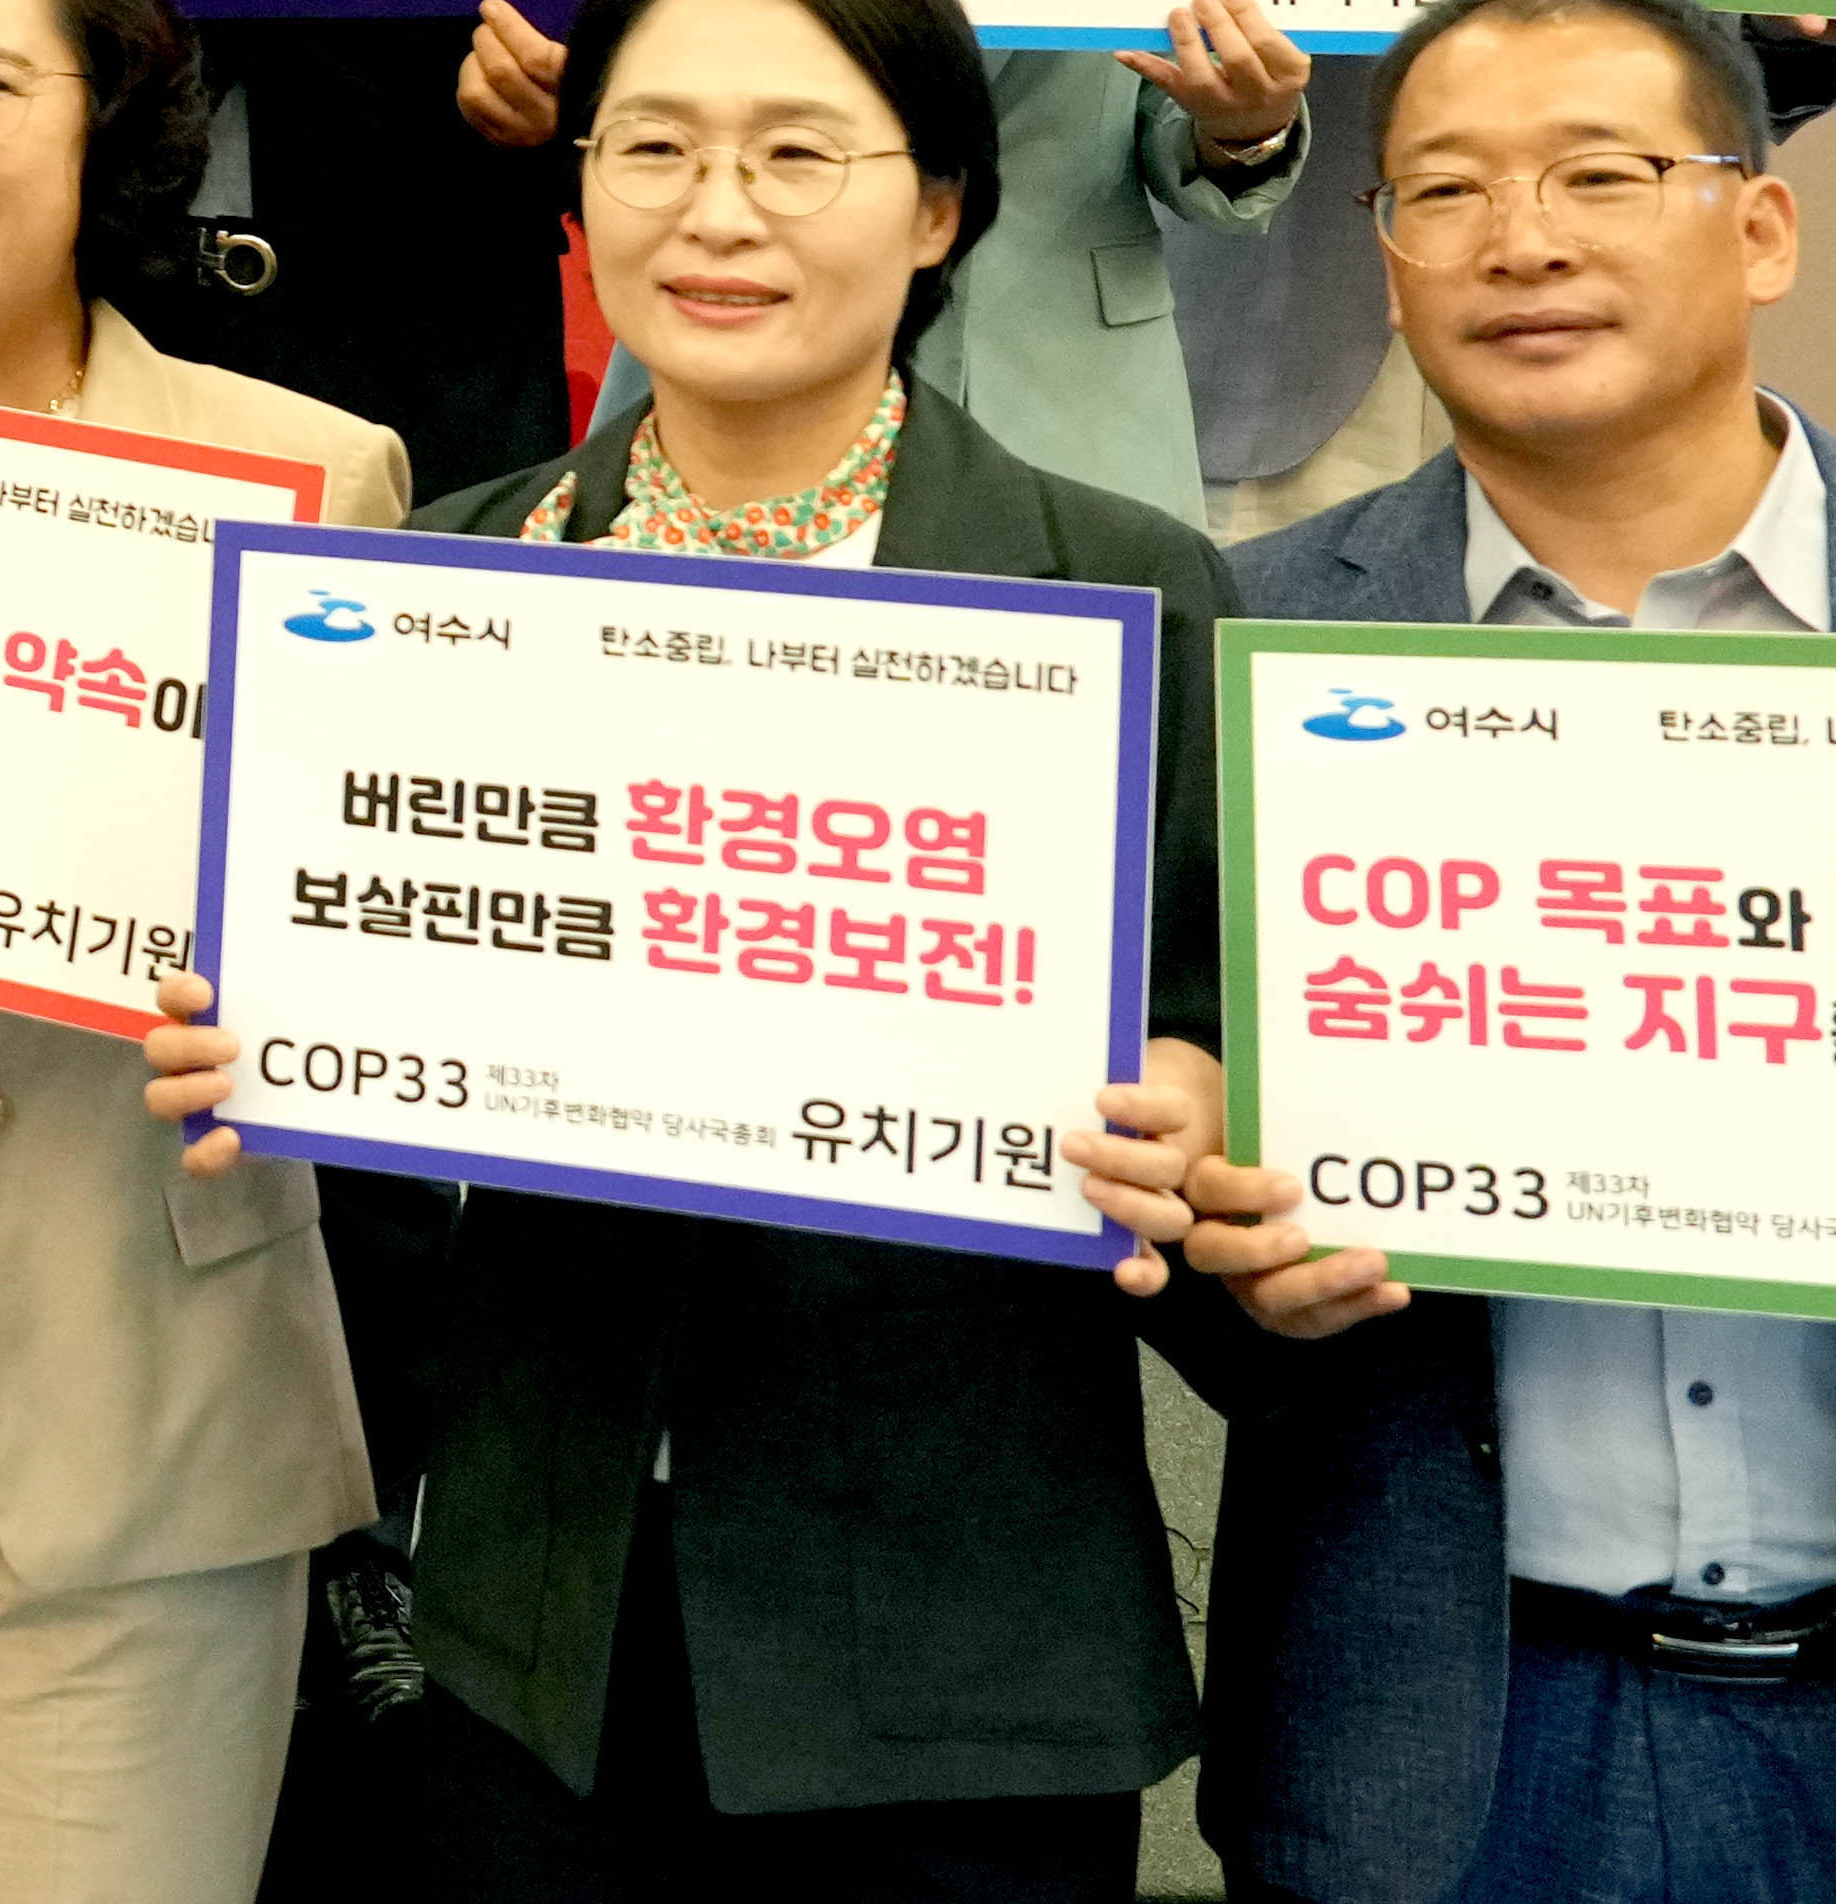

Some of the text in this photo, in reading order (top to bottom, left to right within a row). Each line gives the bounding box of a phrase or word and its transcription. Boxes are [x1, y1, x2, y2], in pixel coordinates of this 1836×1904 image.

[343, 771, 986, 895] 버린만큼 환경오염
[291, 868, 1035, 1006] 보살핀만큼 환경보전!
[1303, 854, 1812, 952] COP 목표와
[1304, 955, 1588, 1051] 숨쉬는
[260, 1038, 1052, 1191] COP33 유치기원
[1310, 1154, 1548, 1219] COP33
